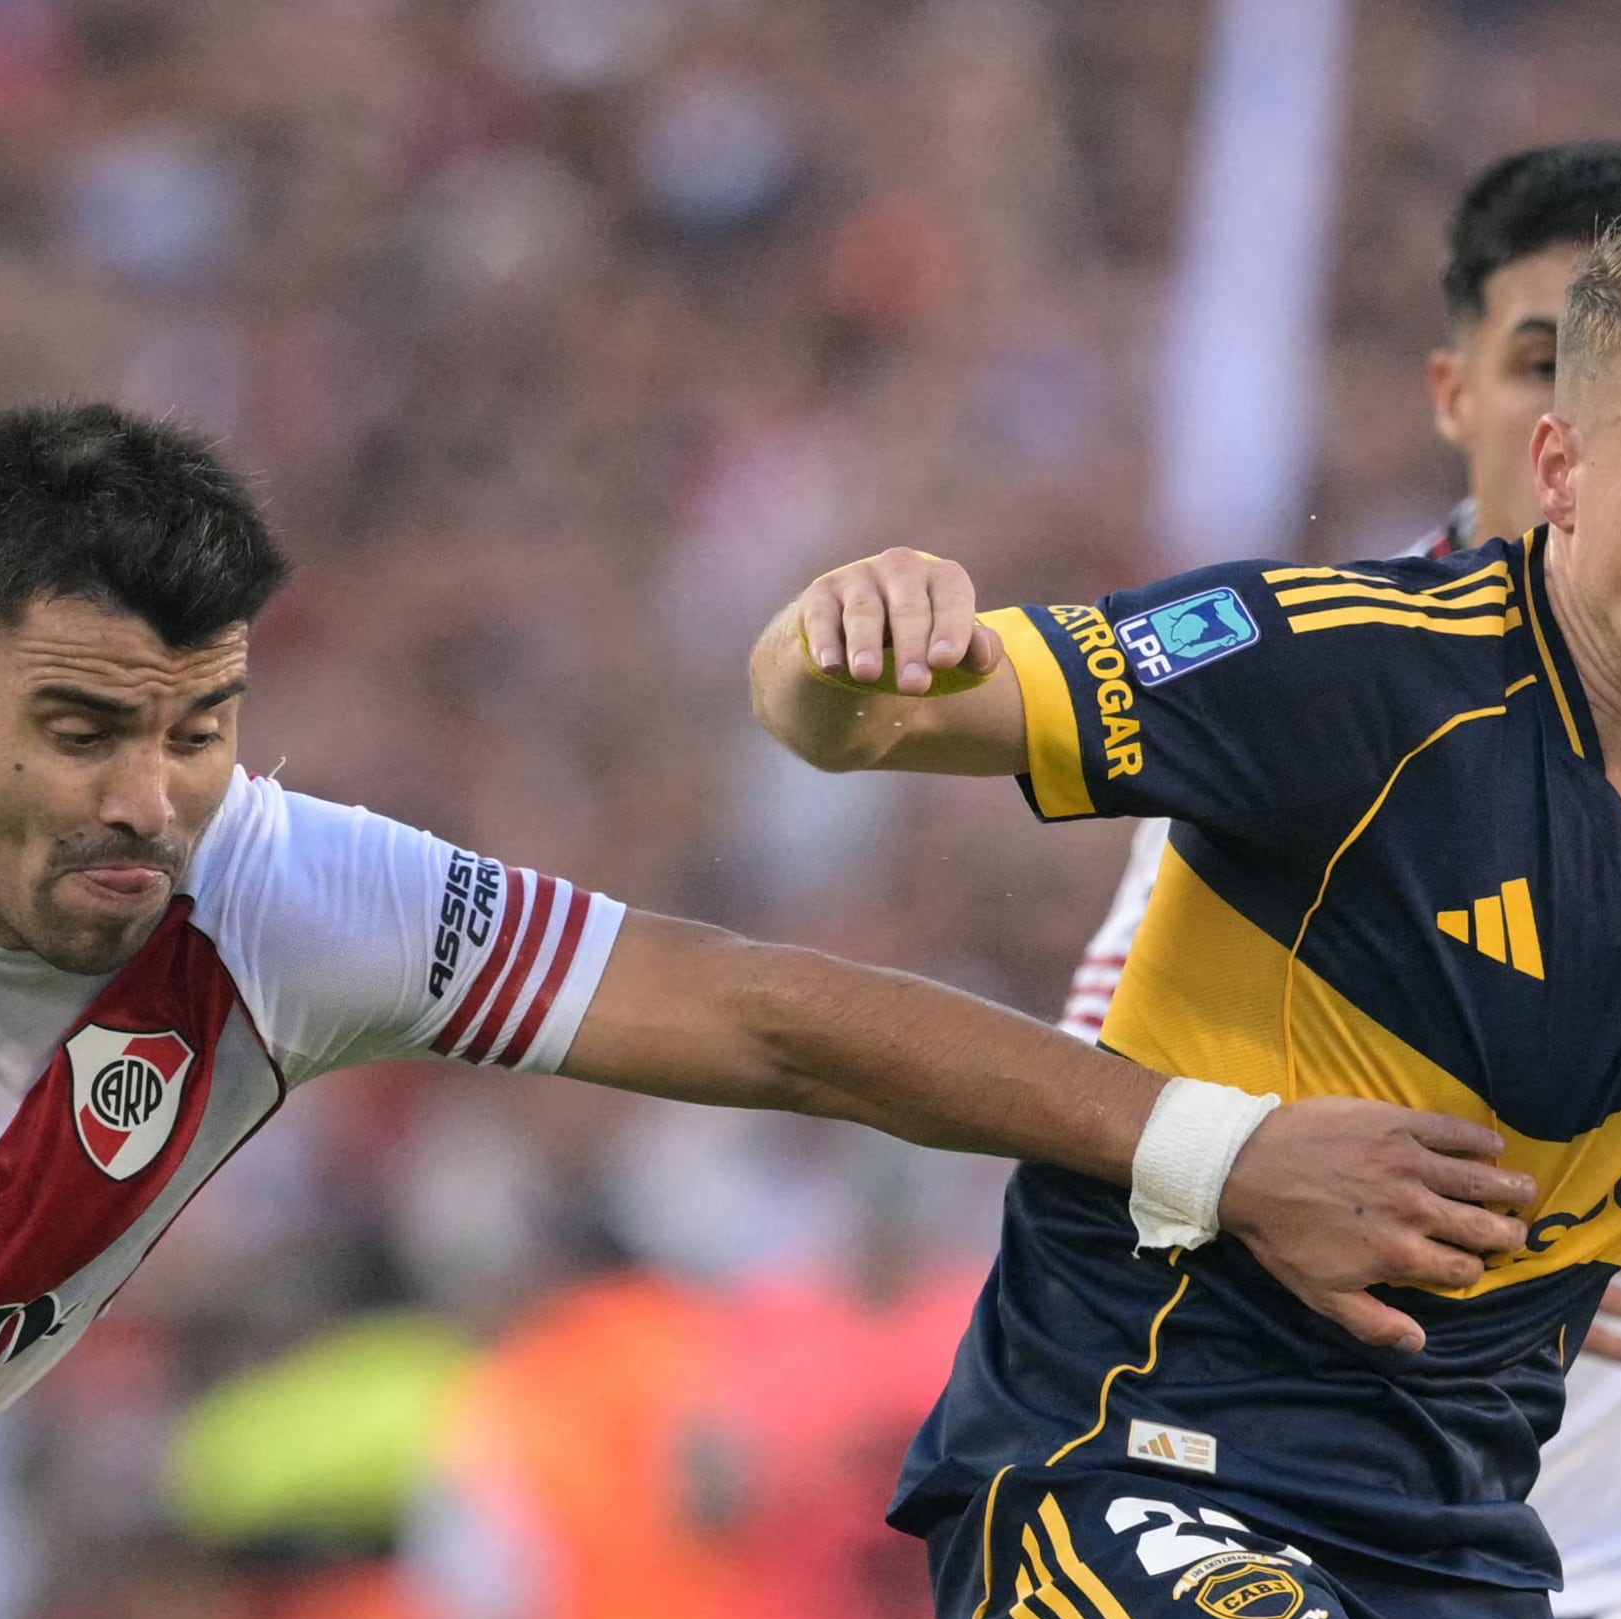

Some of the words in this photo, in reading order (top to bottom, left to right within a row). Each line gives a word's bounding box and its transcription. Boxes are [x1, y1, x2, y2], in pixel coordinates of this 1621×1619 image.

[1118, 617, 1173, 678] LPF
[429, 849, 476, 1000] ASSIST
[90, 1058, 163, 1128] CARP
[1223, 1581, 1287, 1610] CABJ
